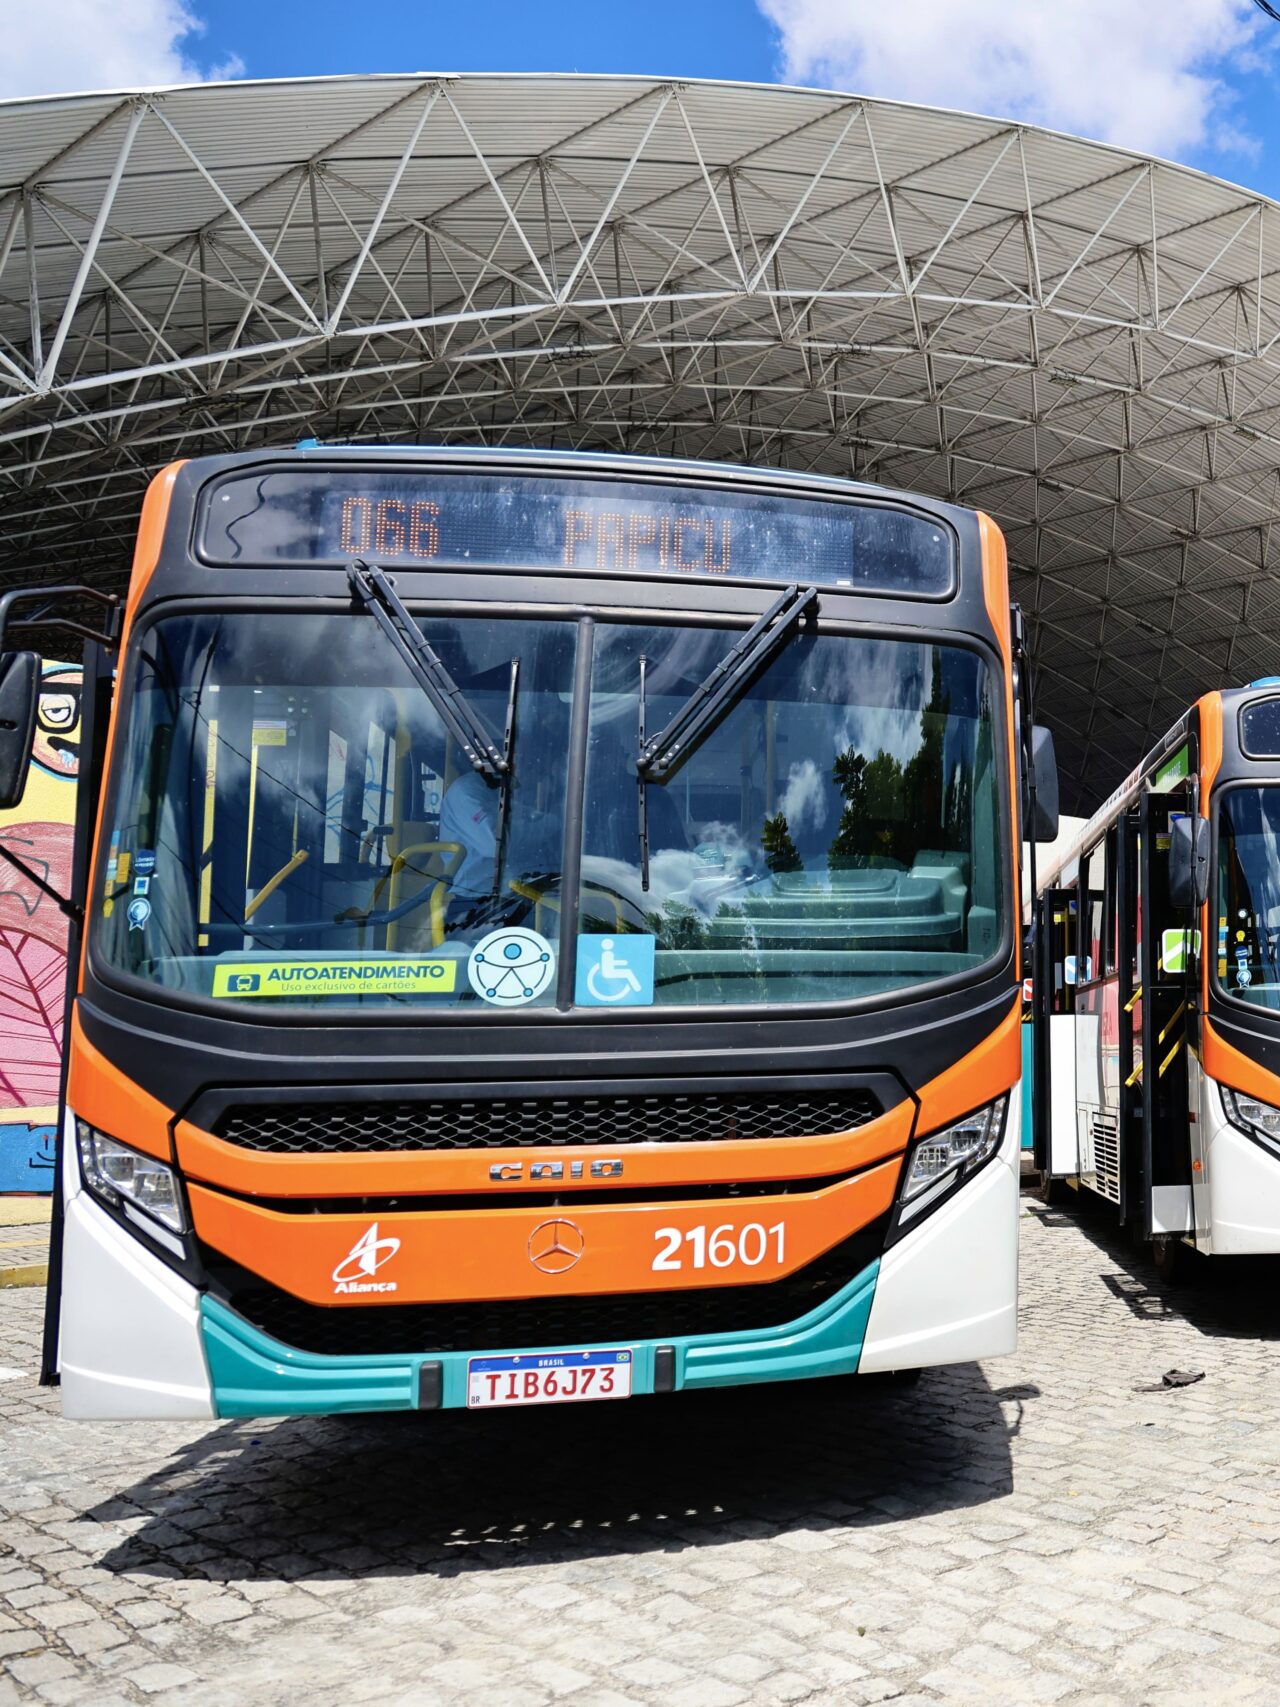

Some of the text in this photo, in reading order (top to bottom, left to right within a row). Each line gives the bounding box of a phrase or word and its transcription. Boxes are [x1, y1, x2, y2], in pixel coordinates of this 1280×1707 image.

[340, 497, 731, 574] 066 PAPICU
[267, 965, 445, 982] AUTOATENDIMENTO
[281, 980, 416, 992] Uso exclusivo de cartões
[651, 1221, 786, 1272] 21601
[333, 1281, 397, 1294] Aliança
[538, 1358, 565, 1367] BRASIL
[485, 1366, 615, 1401] TIB6J73
[471, 1395, 481, 1405] BR
